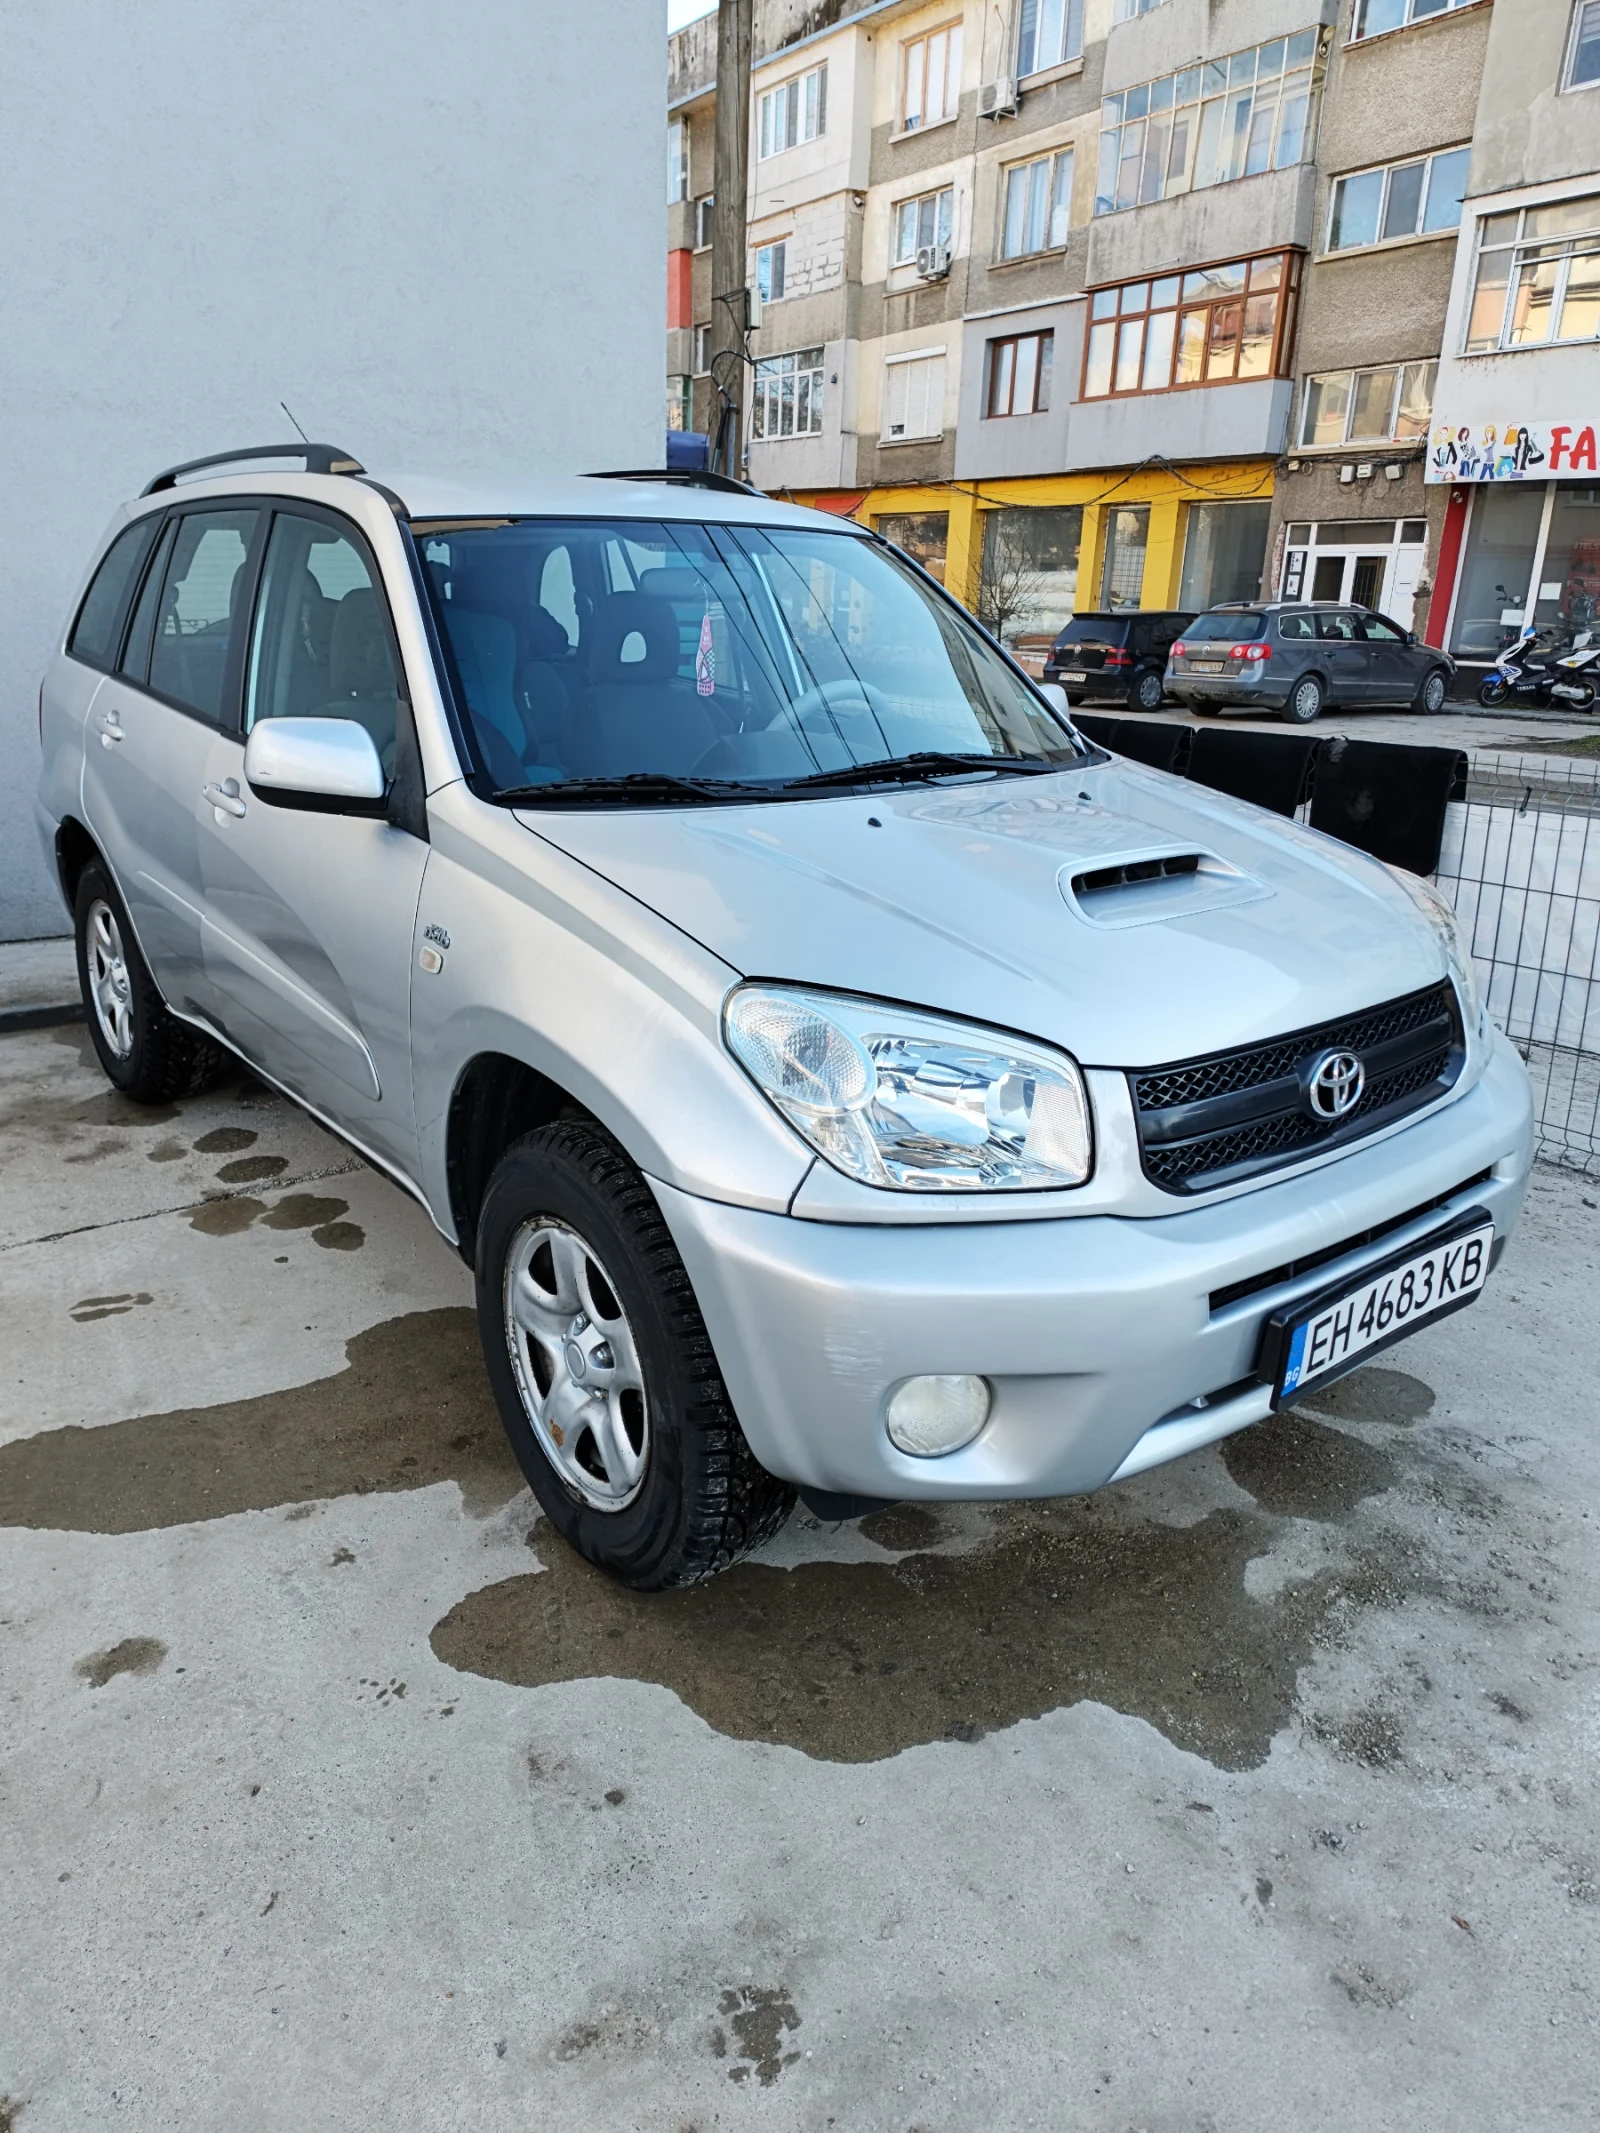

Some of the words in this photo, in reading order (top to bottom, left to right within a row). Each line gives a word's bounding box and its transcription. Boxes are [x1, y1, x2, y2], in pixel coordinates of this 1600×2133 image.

[1549, 426, 1597, 470] FA
[1516, 684, 1536, 692] YAMAHA
[1306, 1301, 1355, 1374] EH
[1357, 1260, 1435, 1339] 4683
[1438, 1239, 1483, 1299] KB
[1284, 1366, 1300, 1387] BG
